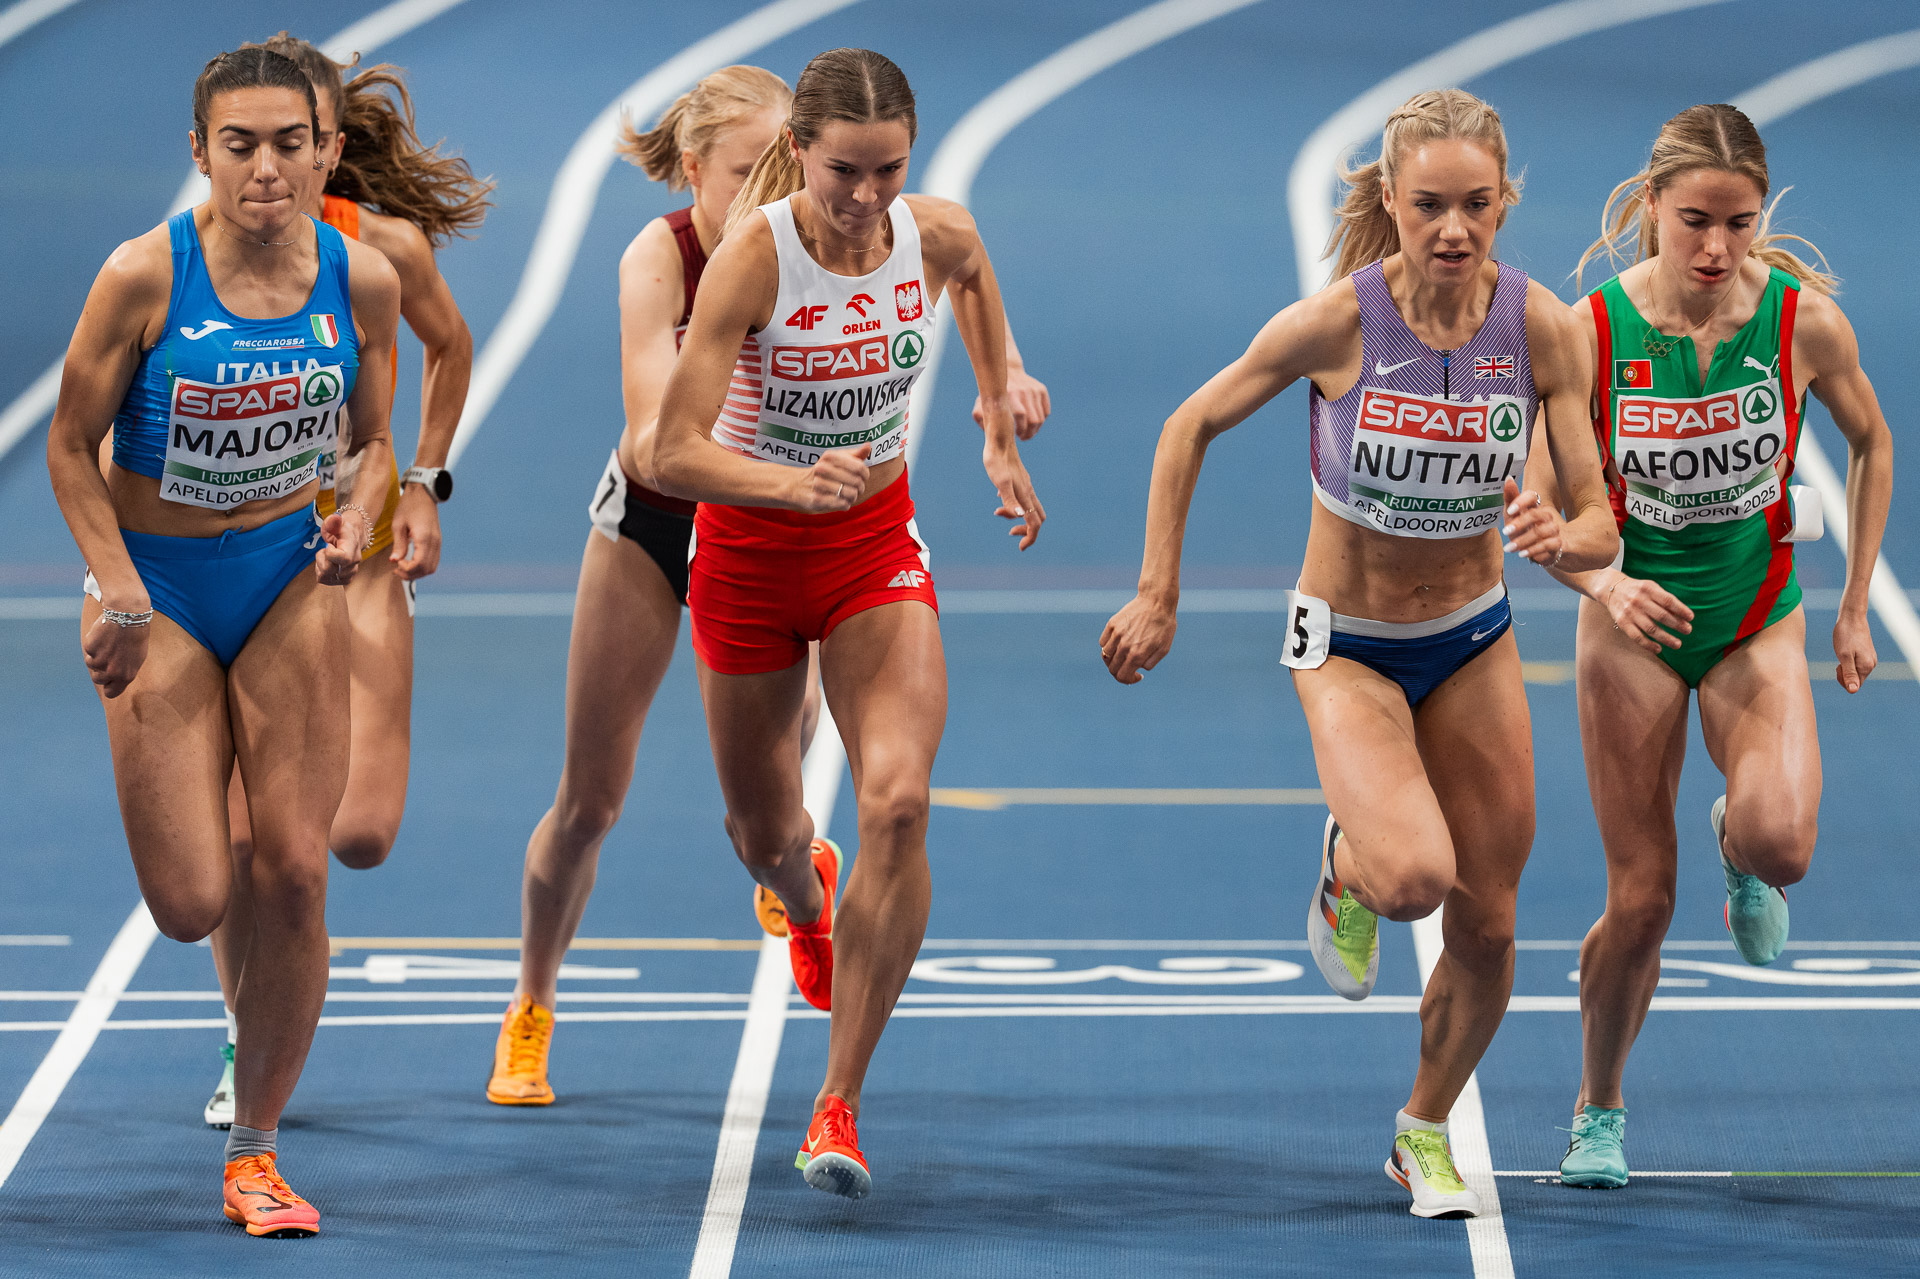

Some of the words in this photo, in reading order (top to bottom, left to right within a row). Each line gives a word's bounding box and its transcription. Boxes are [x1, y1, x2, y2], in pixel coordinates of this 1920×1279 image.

[785, 305, 829, 330] 4F
[842, 319, 881, 335] ORLEN
[233, 338, 305, 347] FRECCIAROSSA
[775, 341, 886, 377] SPAR
[179, 383, 297, 416] SPAR
[765, 374, 913, 420] LIZAKOWSKA
[1364, 397, 1483, 437] SPAR
[1622, 401, 1736, 434] SPAR
[173, 411, 329, 459] MAJORI
[793, 432, 799, 442] I
[802, 433, 836, 446] RUN
[875, 431, 901, 457] 2025
[1354, 441, 1516, 485] NUTTALL
[1621, 433, 1780, 480] AFONSO
[168, 482, 281, 505] APELDOORN
[284, 463, 315, 491] 2025
[202, 471, 206, 481] I
[209, 472, 245, 485] RUN
[596, 470, 617, 513] 7
[1389, 497, 1423, 510] RUN
[1631, 500, 1739, 526] APELDOORN
[1743, 485, 1776, 514] 2025
[1658, 491, 1662, 500] I
[1664, 493, 1696, 507] RUN
[1699, 486, 1746, 504] CLEAN
[1355, 500, 1461, 533] APELDOORN
[1464, 512, 1500, 530] 2025
[887, 570, 925, 588] 4F
[1292, 606, 1309, 659] 5
